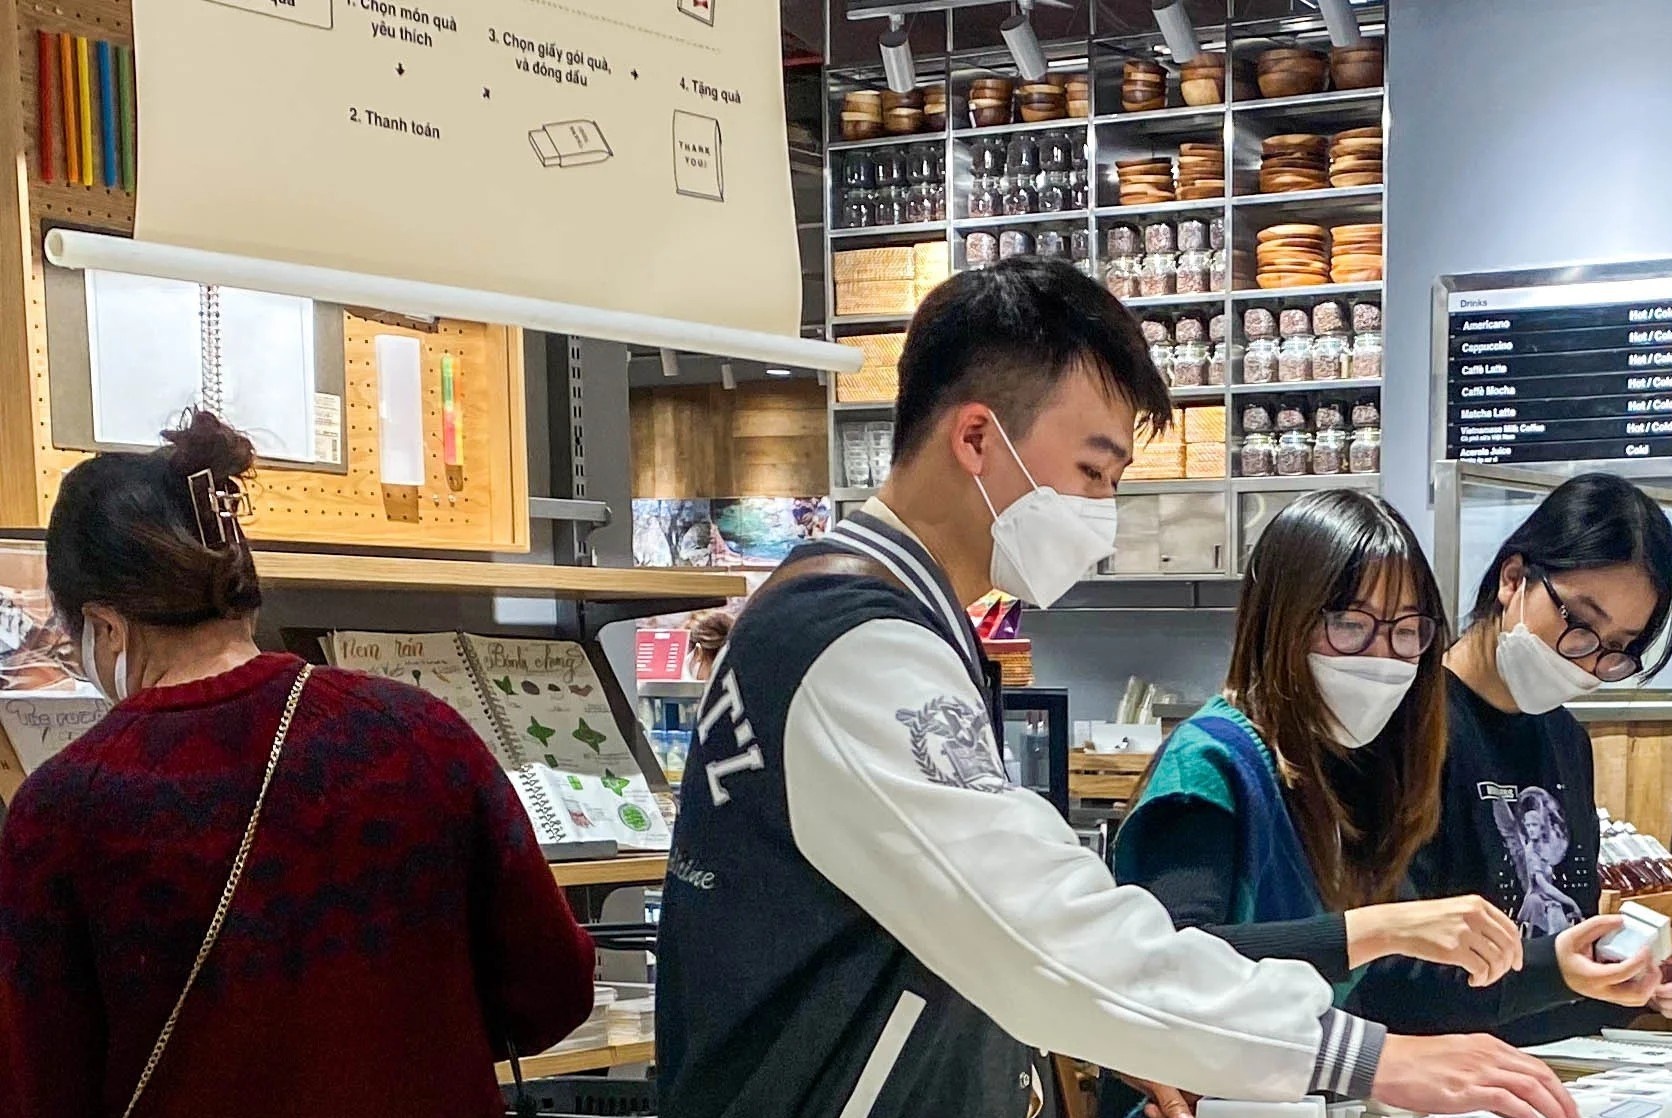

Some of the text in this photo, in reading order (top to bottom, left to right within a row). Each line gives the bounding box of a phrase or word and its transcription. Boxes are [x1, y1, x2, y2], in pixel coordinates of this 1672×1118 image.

[400, 5, 429, 25] món
[433, 14, 457, 32] quà
[371, 20, 433, 48] yêu thích
[488, 28, 499, 45] 3.
[503, 31, 535, 54] Chọn
[538, 41, 562, 62] giấy
[566, 49, 584, 67] gói
[515, 57, 588, 87] và đóng dấu
[679, 76, 742, 105] 4. Tặng quà
[350, 107, 440, 140] 2. Thanh toán
[678, 140, 711, 156] THANK
[1460, 299, 1488, 308] Drinks
[1462, 319, 1511, 331] Americano
[1629, 309, 1648, 321] Hot
[1461, 341, 1513, 354] Cappuccino
[1629, 332, 1648, 343] Hot
[1485, 364, 1508, 373] Latte
[1629, 354, 1648, 366] Hot
[1486, 385, 1516, 396] Mocha
[1627, 378, 1647, 389] Hot
[1493, 408, 1517, 417] Latte
[1627, 400, 1647, 412] Hot
[1626, 423, 1645, 434] Hot
[1625, 444, 1649, 455] Cold
